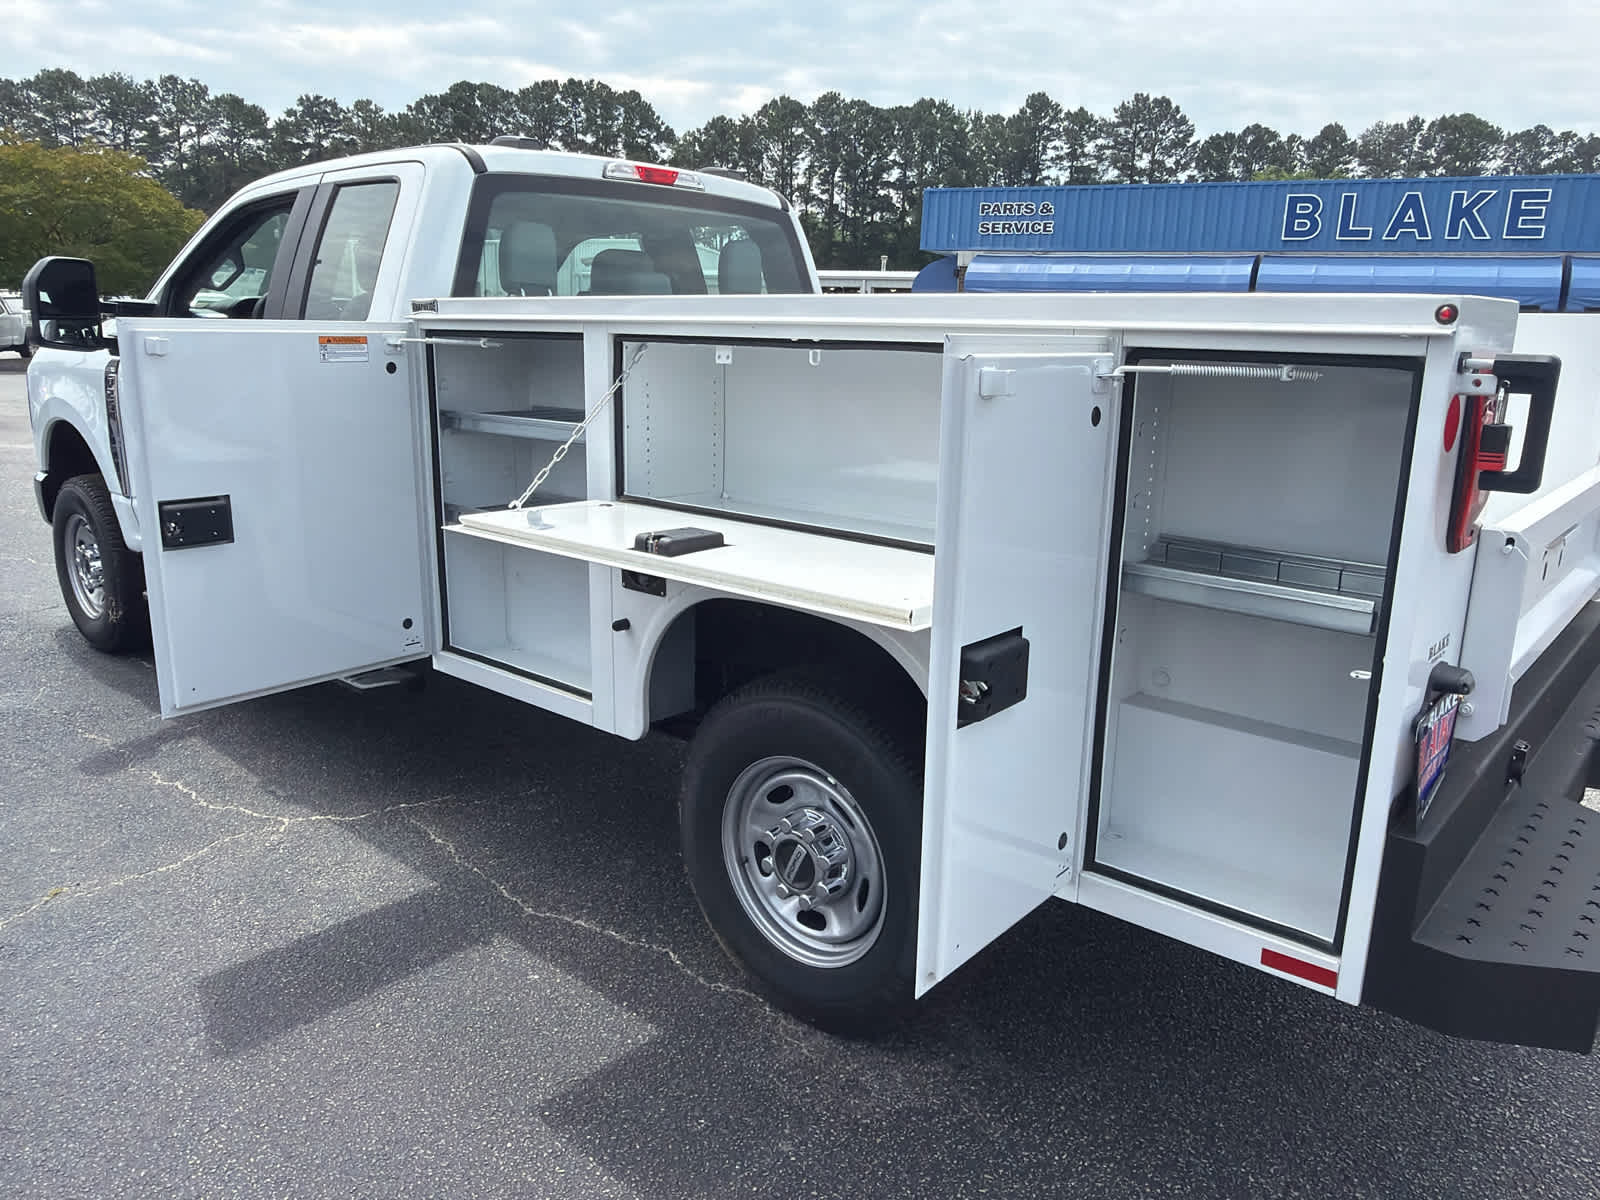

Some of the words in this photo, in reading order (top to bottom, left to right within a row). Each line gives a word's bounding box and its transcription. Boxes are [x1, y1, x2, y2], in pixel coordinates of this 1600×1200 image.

[979, 202, 1036, 216] PARTS
[1039, 202, 1054, 216] &
[1281, 188, 1553, 241] BLAKE
[978, 221, 1054, 235] SERVICE
